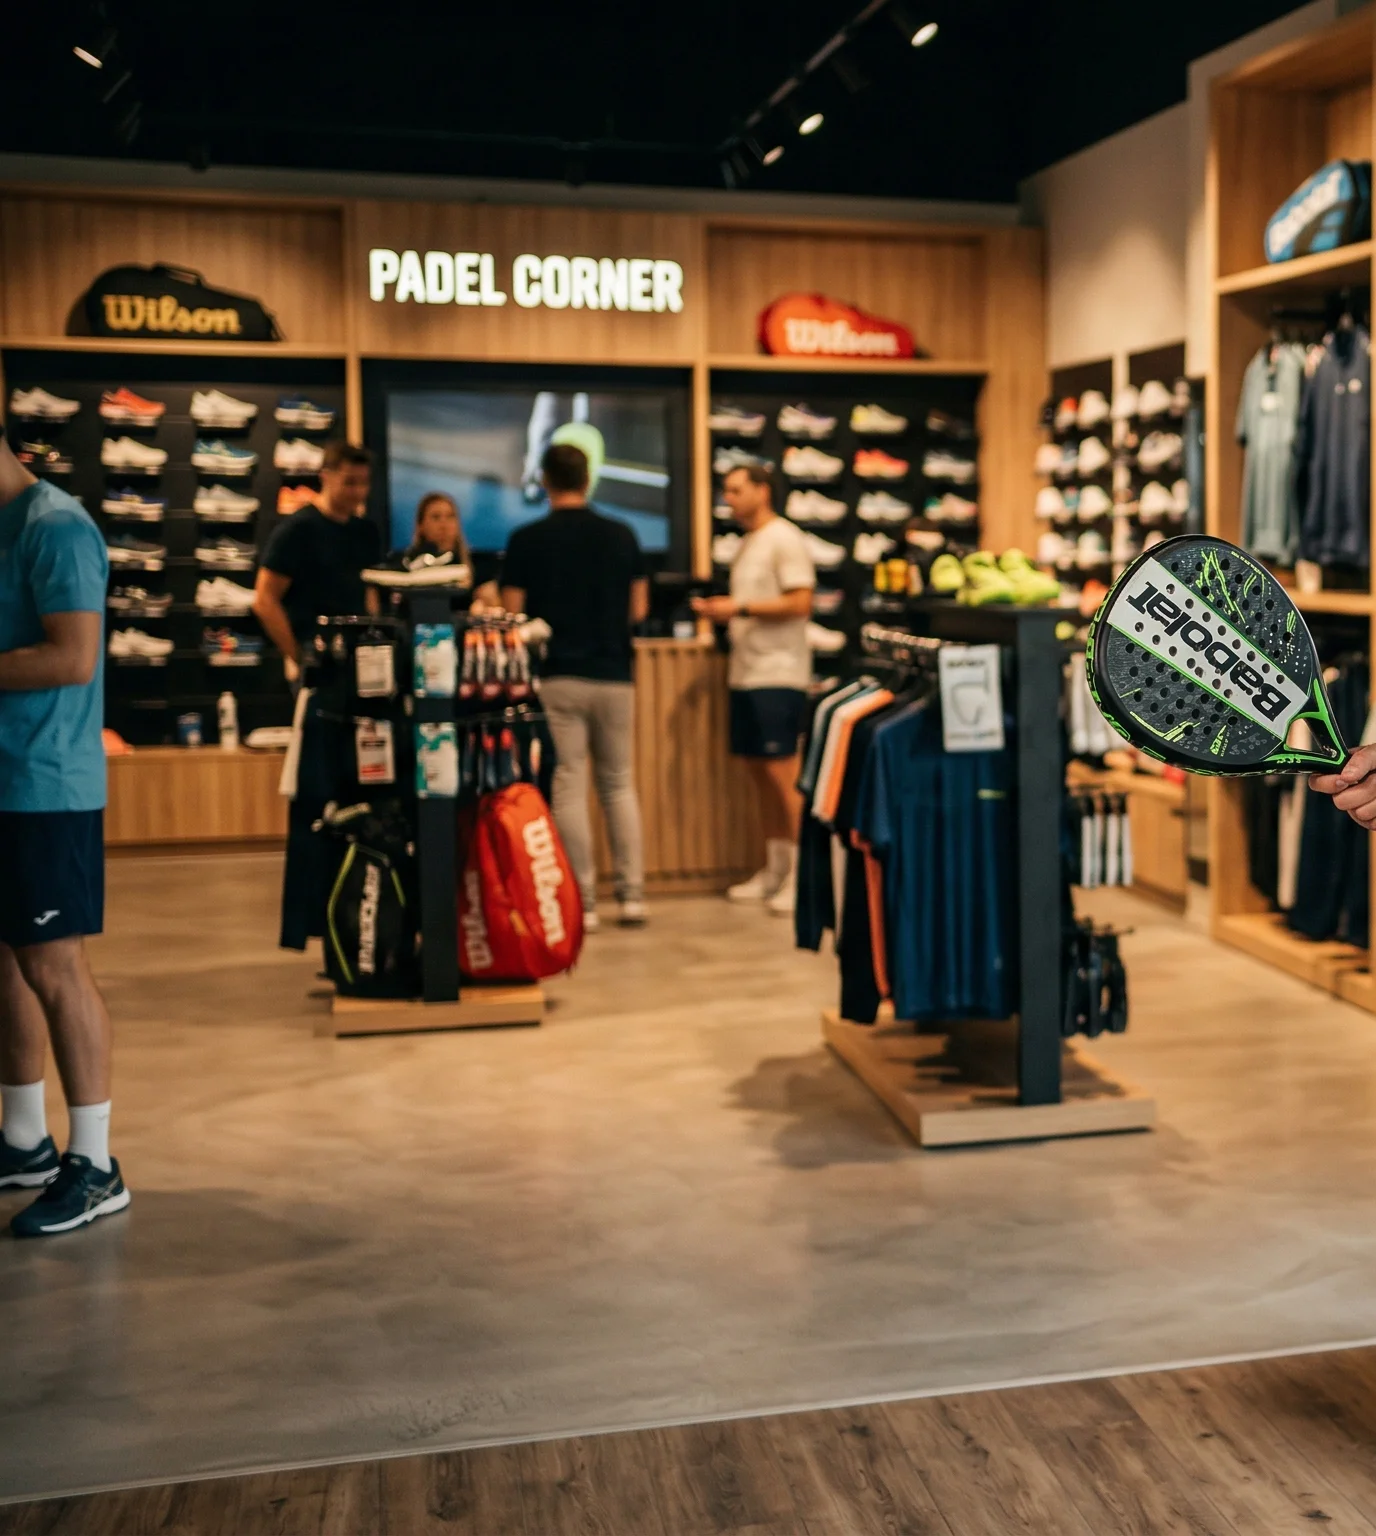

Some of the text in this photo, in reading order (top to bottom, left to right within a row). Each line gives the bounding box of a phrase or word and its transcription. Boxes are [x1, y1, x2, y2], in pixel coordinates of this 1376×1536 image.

[369, 248, 684, 313] PADEL CORNER
[102, 294, 243, 334] Wilson
[522, 815, 566, 949] Wilson
